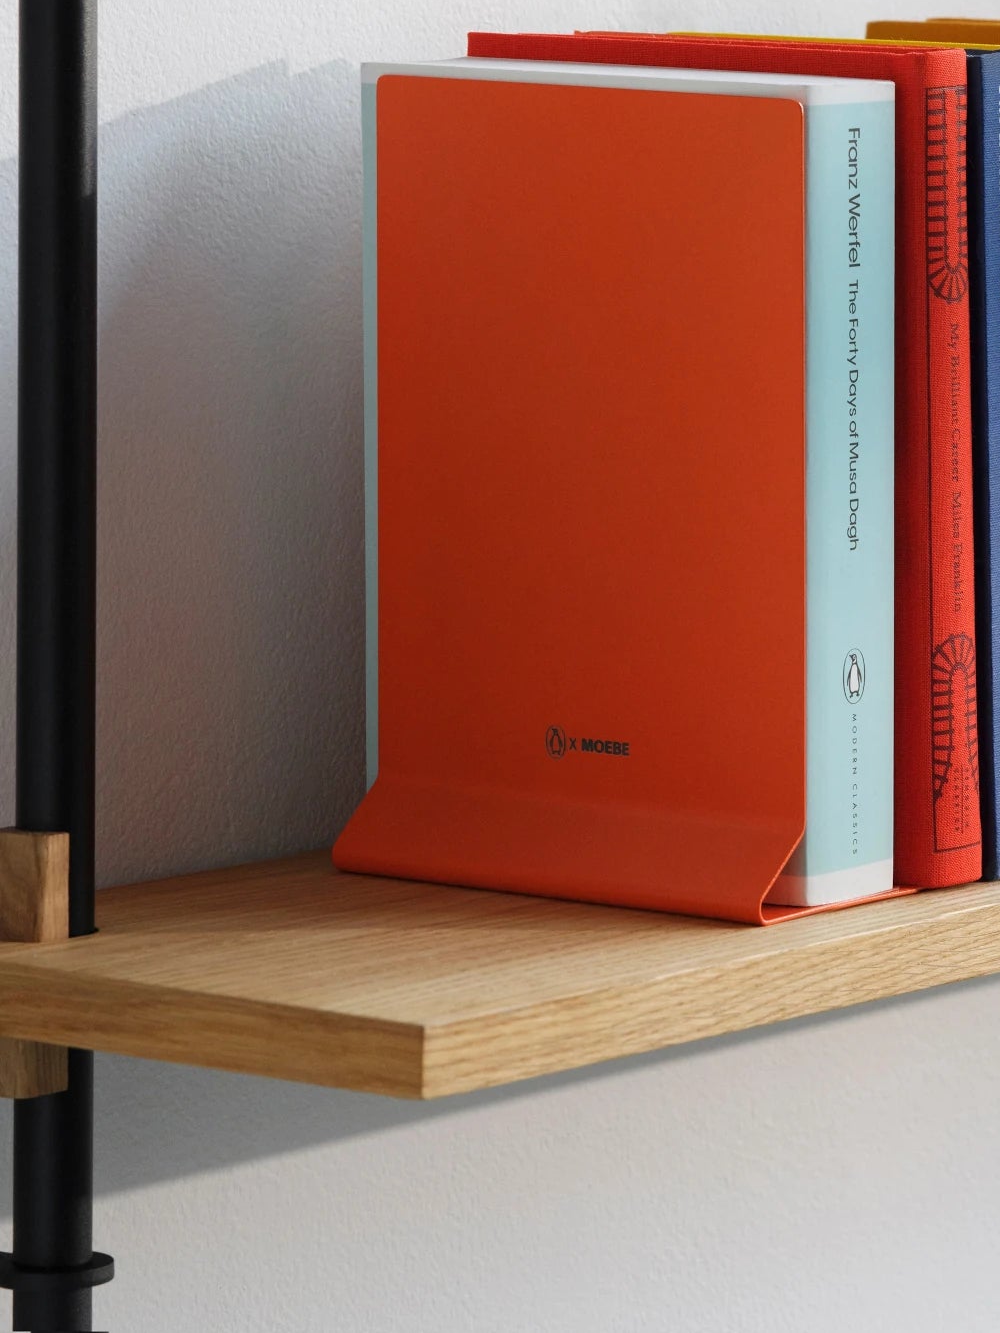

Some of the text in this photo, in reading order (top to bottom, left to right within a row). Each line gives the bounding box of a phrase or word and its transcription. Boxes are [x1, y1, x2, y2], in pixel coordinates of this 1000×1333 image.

[845, 126, 861, 552] Franz Werfel The Forty Days of Musa Dagh
[948, 322, 963, 613] My Brilliant Career Miles Franklin
[581, 738, 630, 756] MOEBE
[851, 783, 859, 855] CLASSICS
